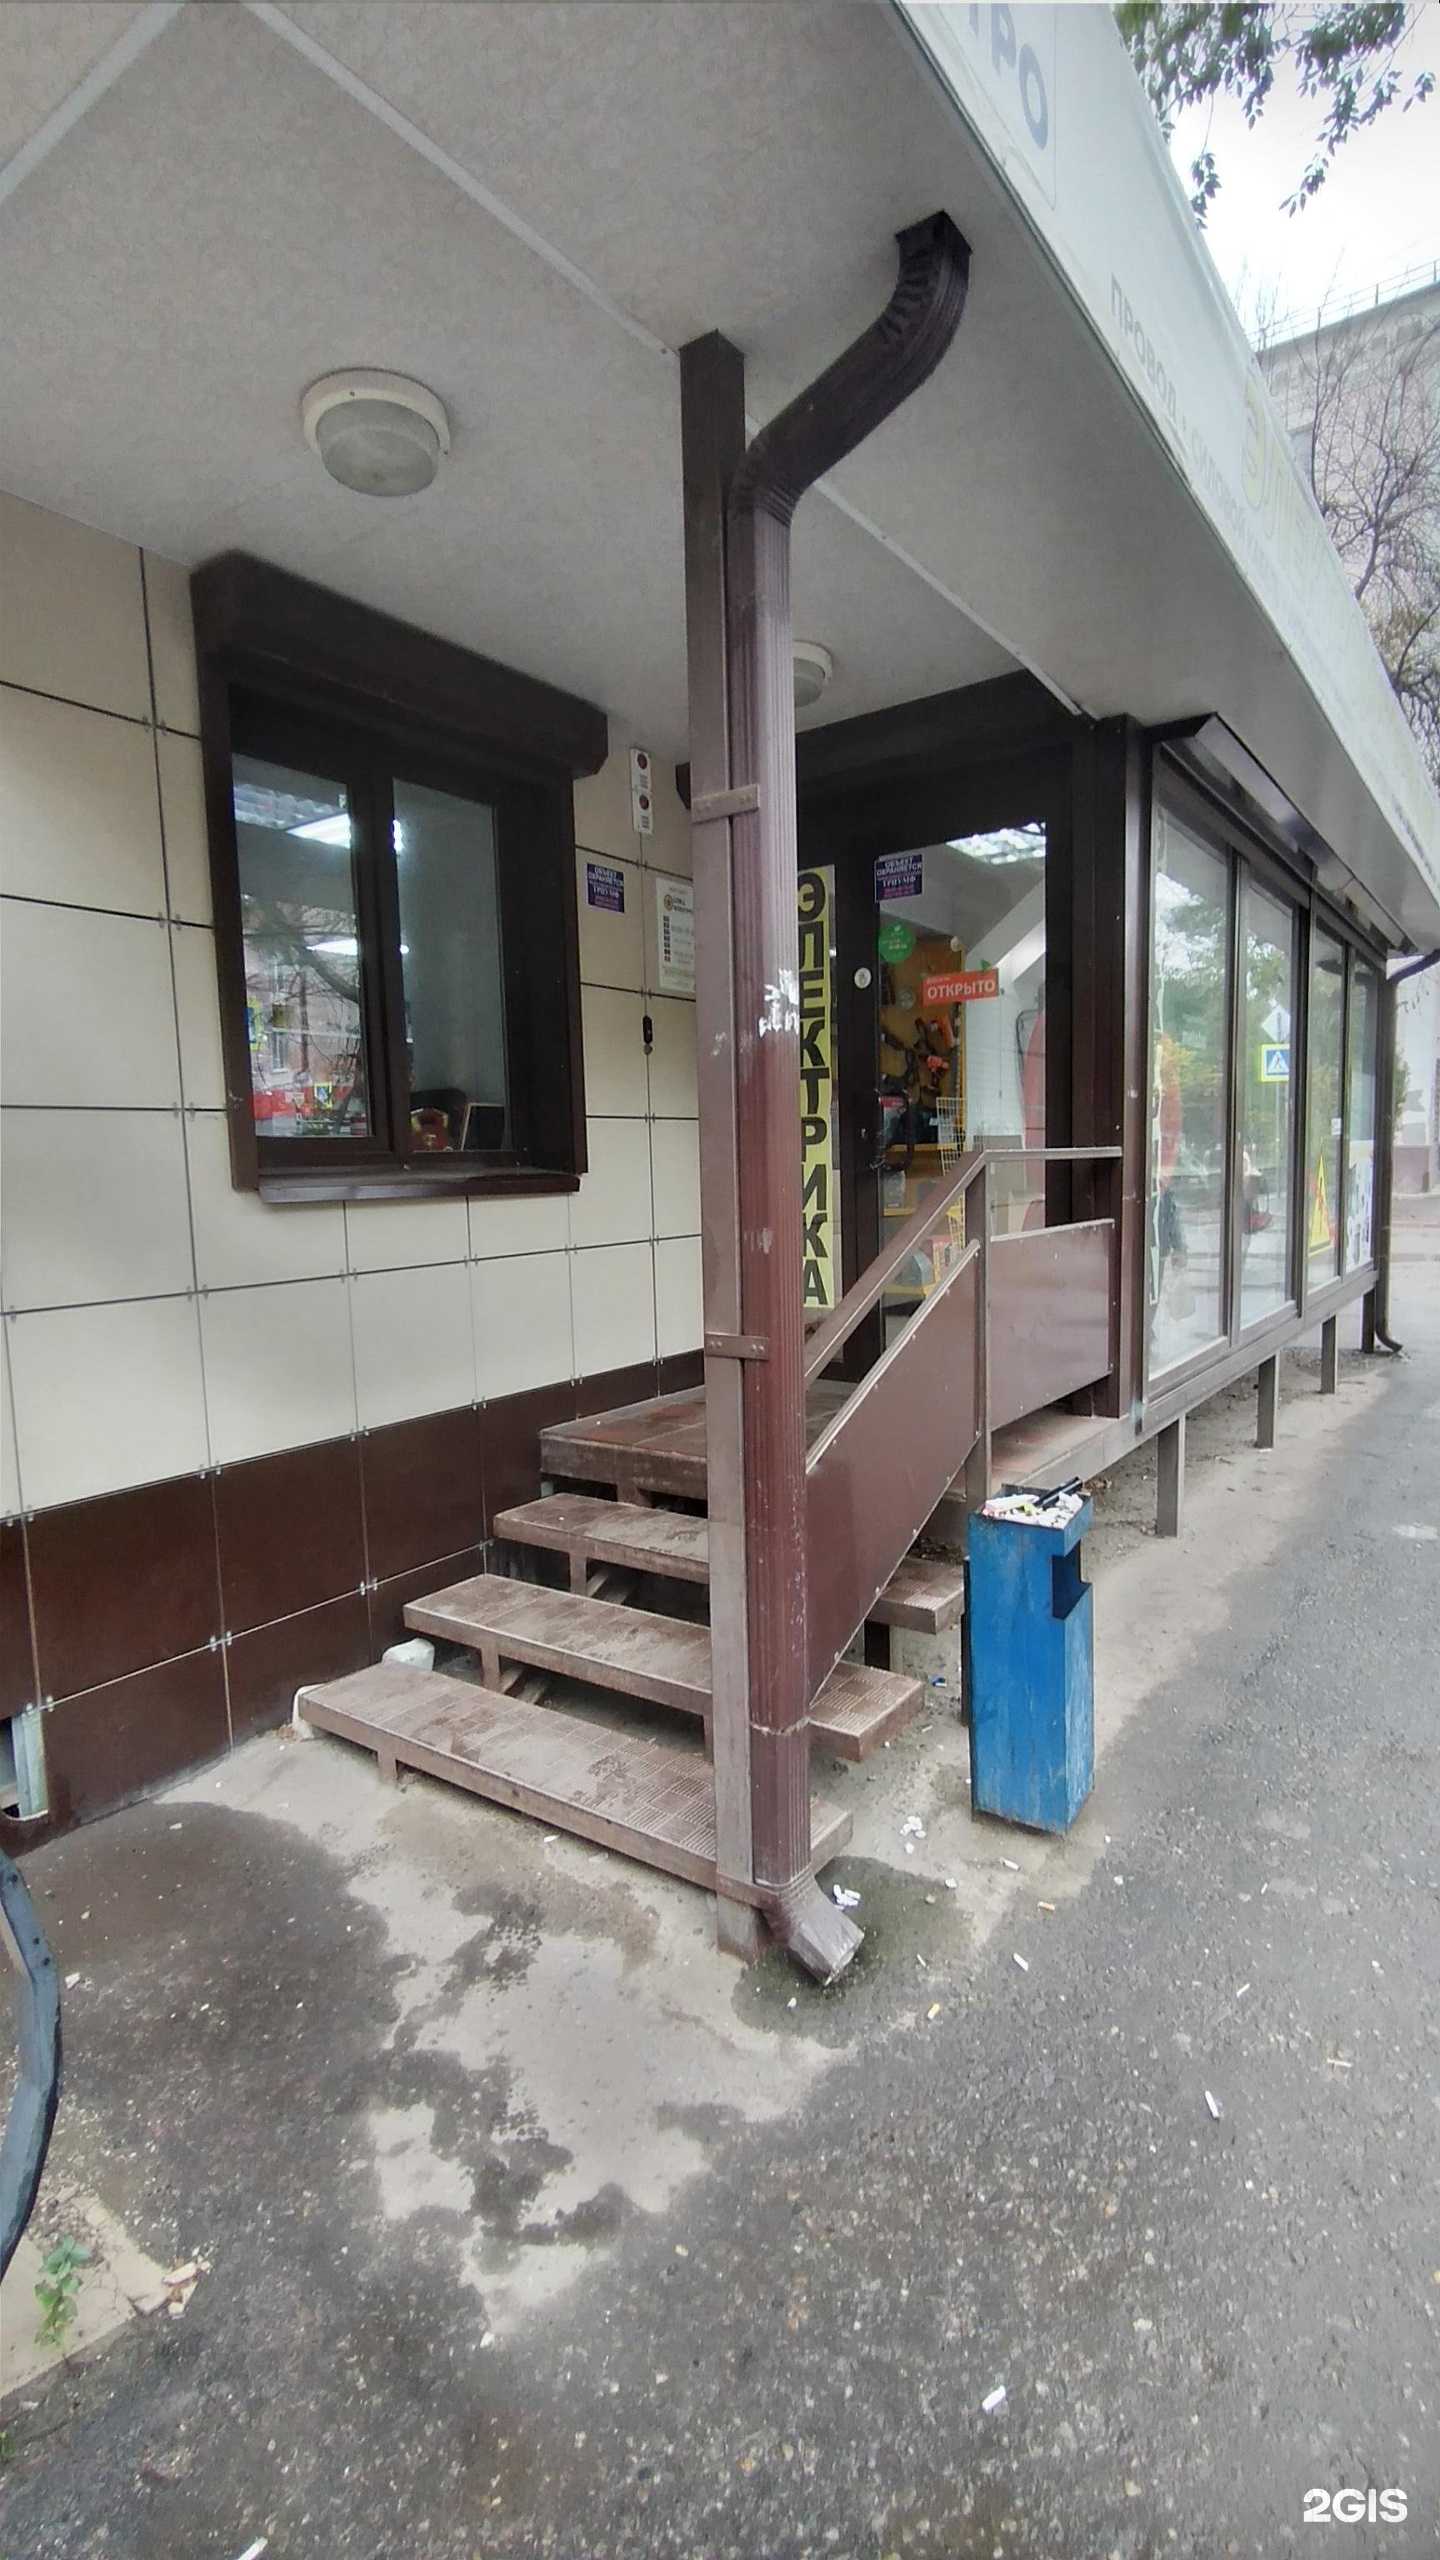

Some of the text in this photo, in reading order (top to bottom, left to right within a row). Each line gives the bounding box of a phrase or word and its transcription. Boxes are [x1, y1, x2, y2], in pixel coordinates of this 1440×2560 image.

[1111, 272, 1178, 426] ПРОВОД
[927, 979, 996, 1000] ОТКРЫТО
[798, 871, 831, 1305] ЭЛЕКТРИКА
